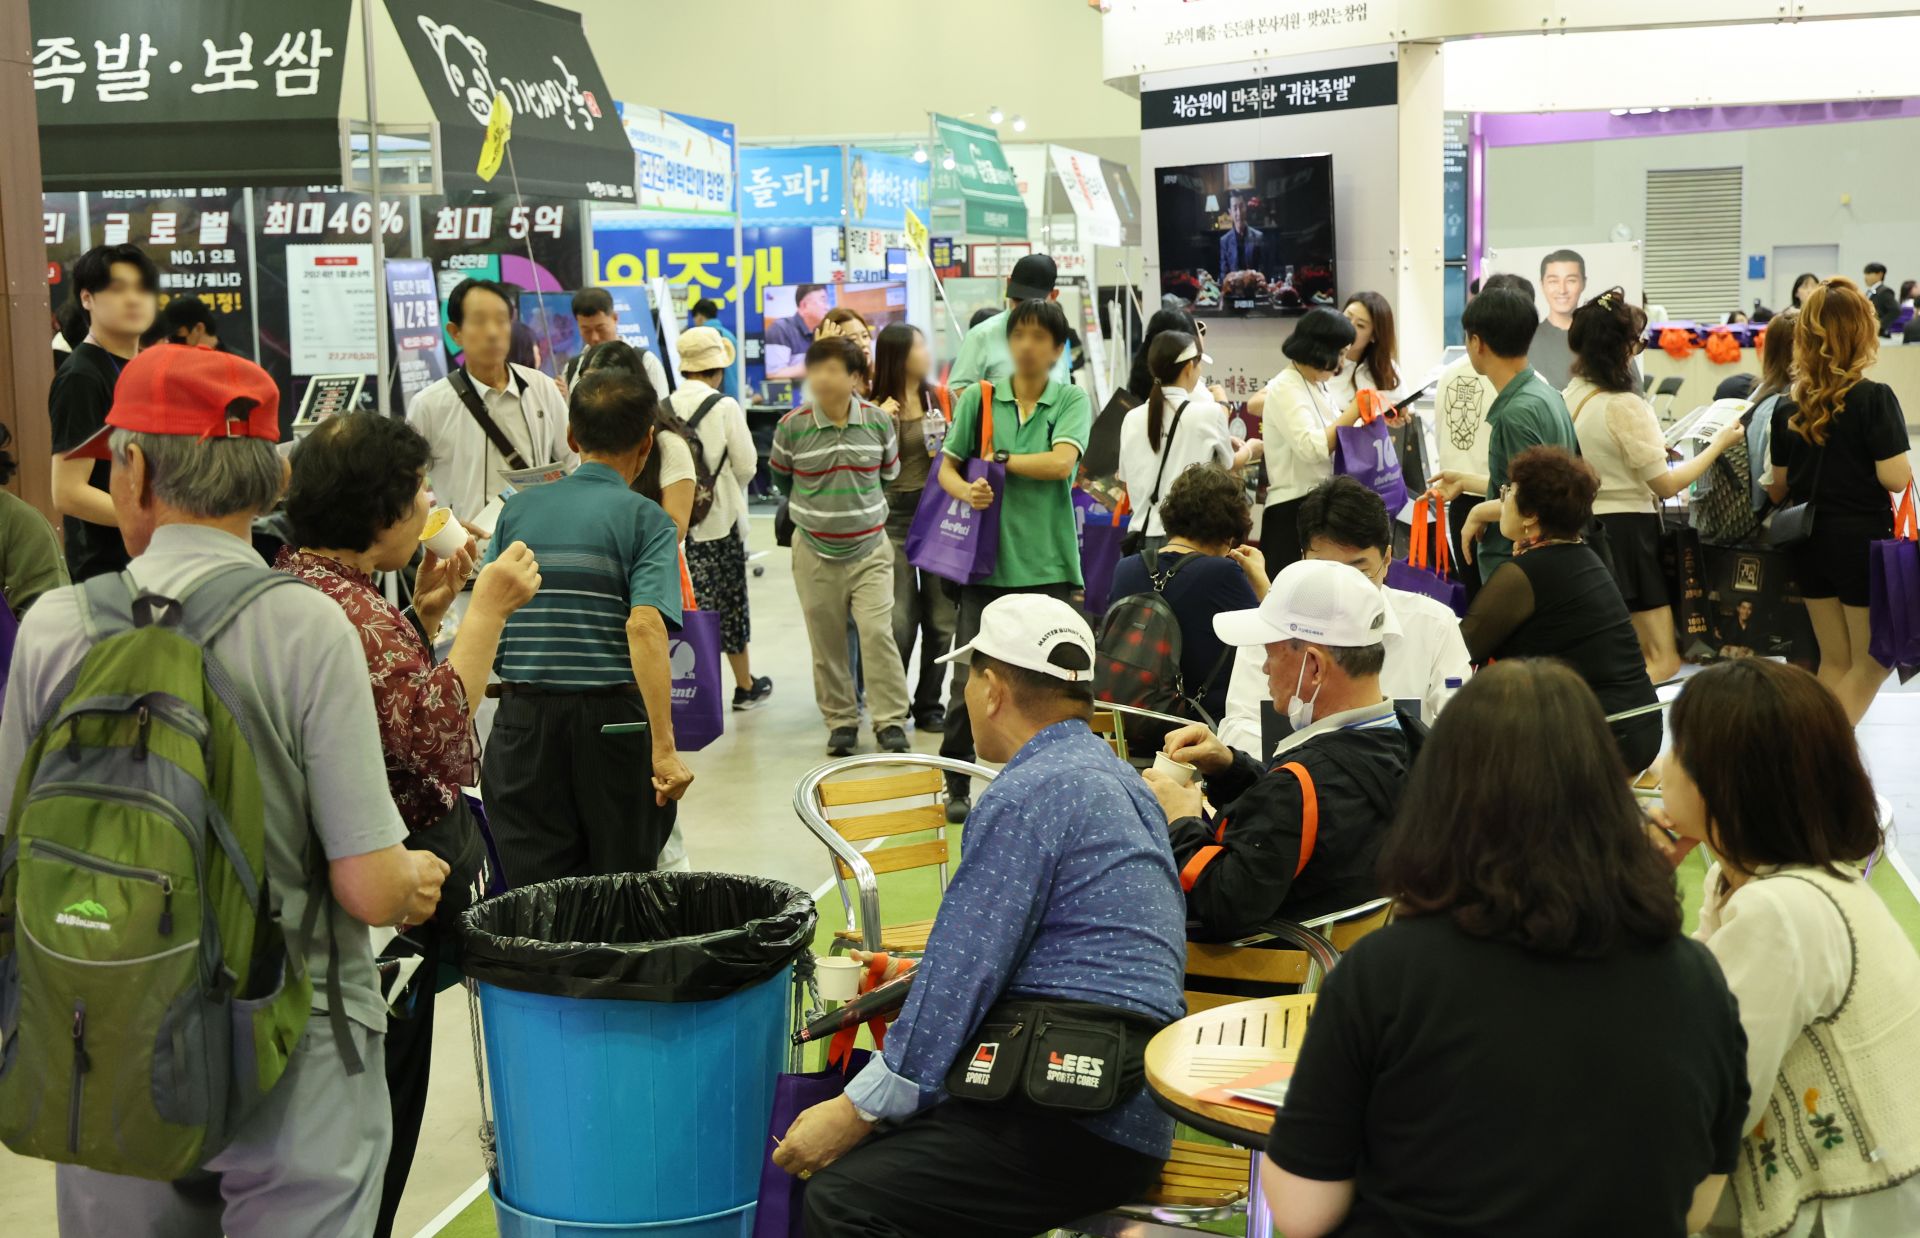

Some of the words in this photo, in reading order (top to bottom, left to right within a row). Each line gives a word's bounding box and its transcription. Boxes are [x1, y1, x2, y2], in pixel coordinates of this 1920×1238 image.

[1345, 3, 1367, 22] 창업
[1172, 90, 1228, 119] 차승원이
[1231, 84, 1278, 113] 만족한
[1279, 75, 1356, 106] "귀한족발"
[743, 163, 831, 209] 돌파!
[433, 206, 493, 240] 최대
[508, 205, 564, 239] 5억
[170, 249, 206, 265] NO.1
[209, 248, 237, 264] 으로
[1047, 1050, 1105, 1078] LEES
[965, 1072, 991, 1086] SPORTS
[1046, 1070, 1077, 1085] SPORTS
